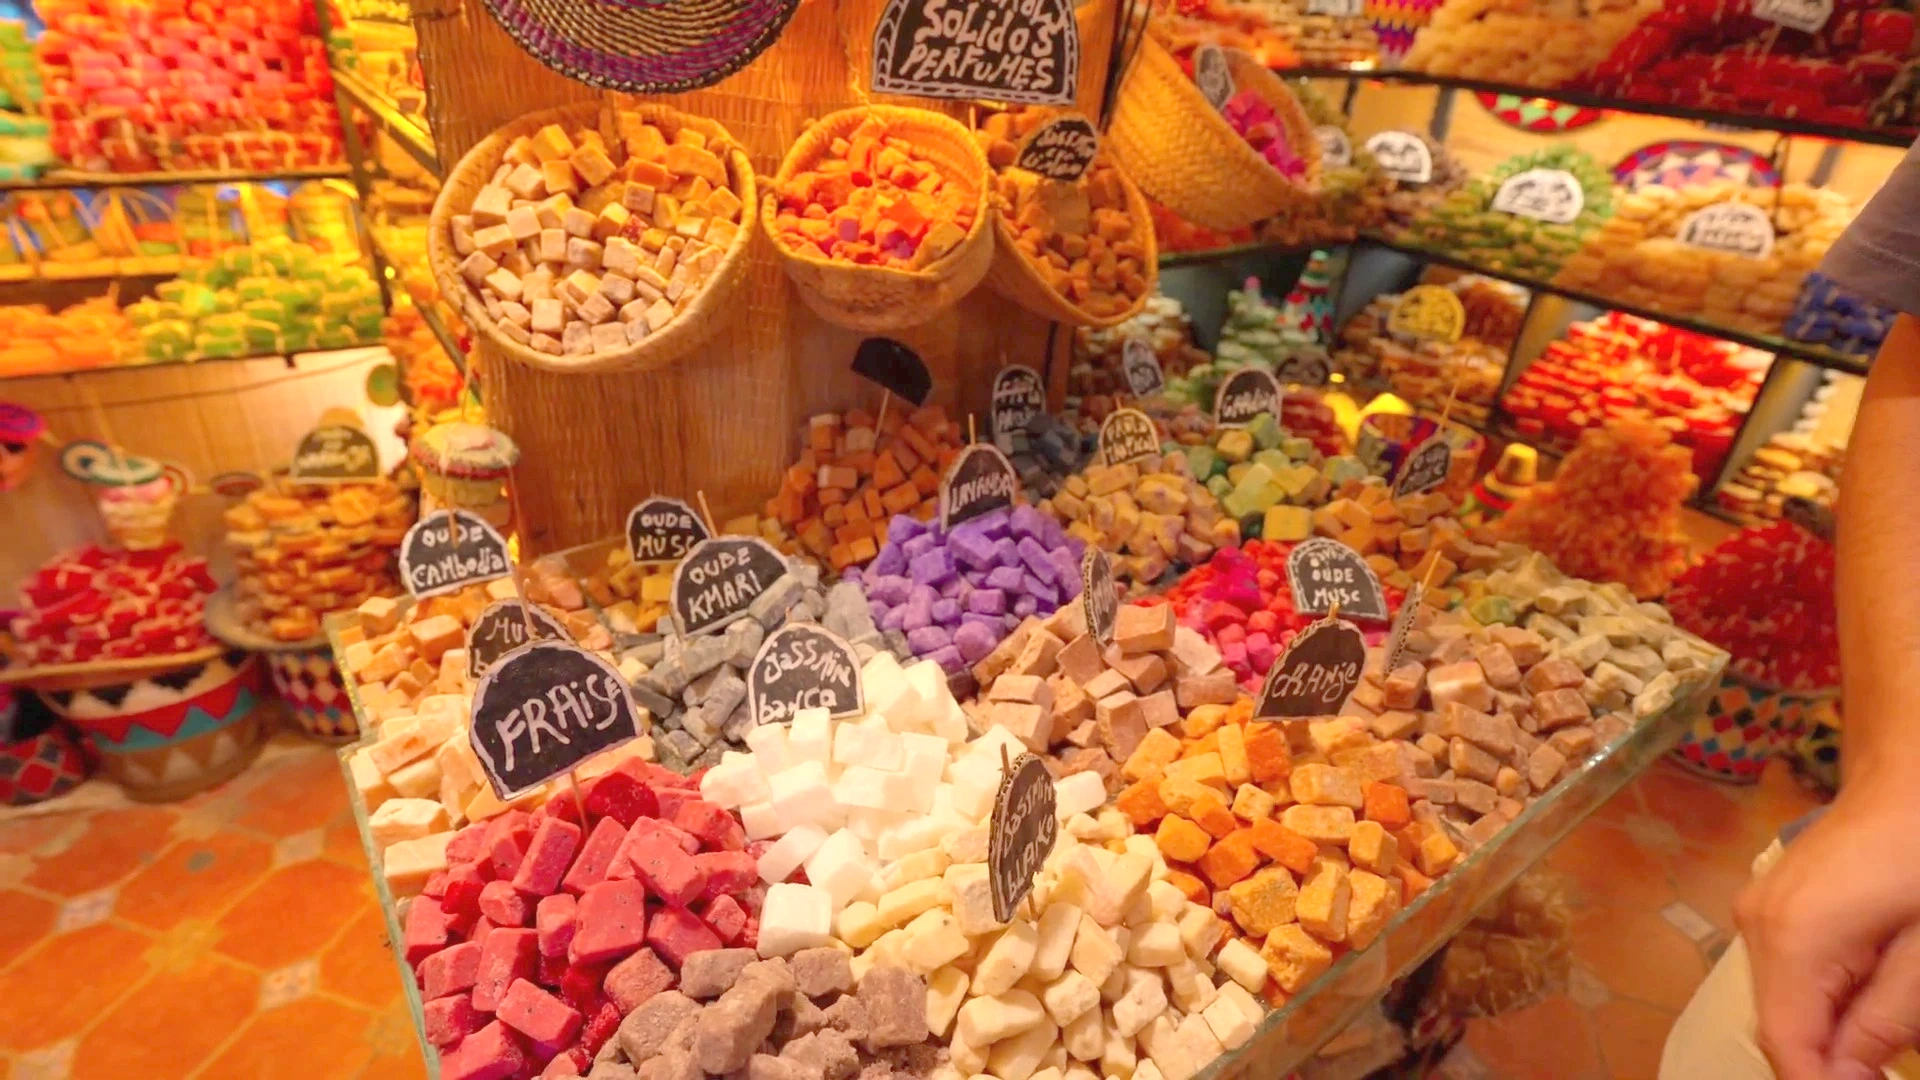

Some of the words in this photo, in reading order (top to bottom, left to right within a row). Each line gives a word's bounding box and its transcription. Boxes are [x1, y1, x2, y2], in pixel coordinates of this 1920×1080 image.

[640, 512, 693, 529] OUDE
[689, 546, 752, 585] OUDE
[1311, 567, 1355, 583] OUDE
[687, 569, 763, 624] KMARI
